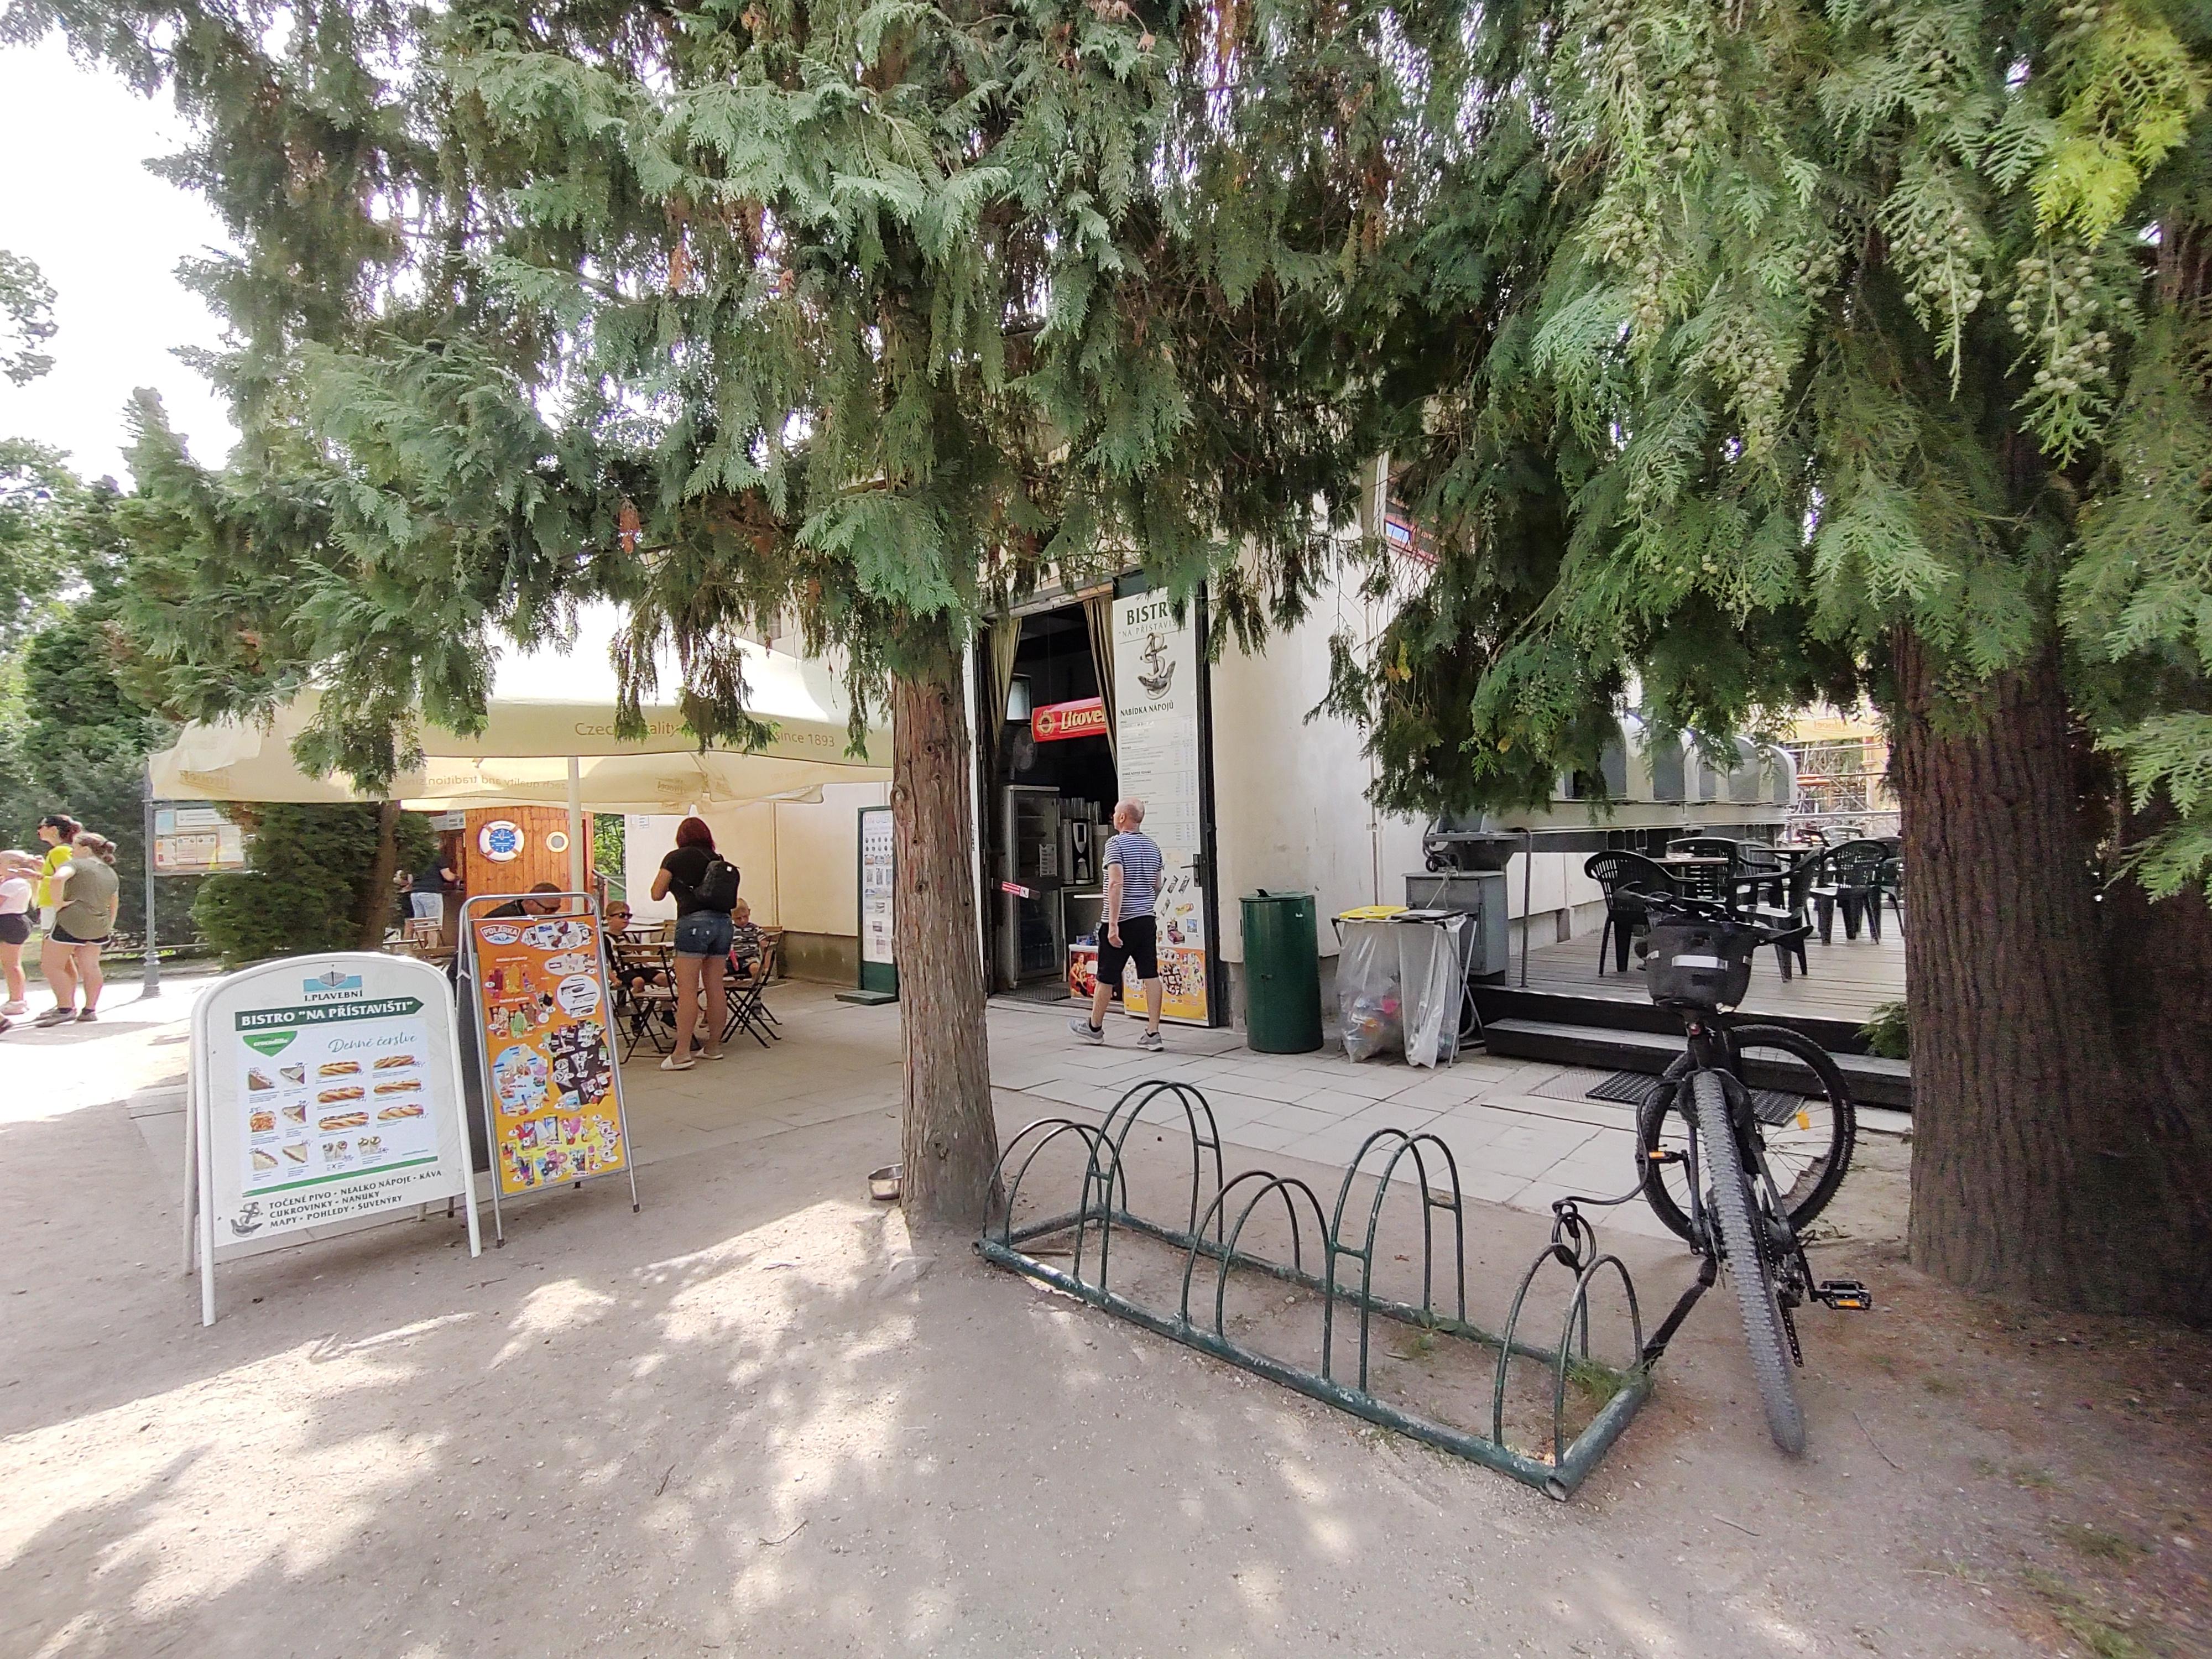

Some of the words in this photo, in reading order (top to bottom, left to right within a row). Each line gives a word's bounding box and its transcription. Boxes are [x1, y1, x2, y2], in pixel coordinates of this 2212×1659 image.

[1127, 602, 1168, 625] BISTR
[1120, 706, 1147, 717] NABÍDKA
[1149, 700, 1173, 712] NÁPOJŮ
[575, 722, 614, 735] Czec
[650, 721, 677, 737] ality
[775, 731, 805, 744] since
[808, 733, 835, 747] 1893
[241, 1012, 295, 1026] BISTRO
[328, 1038, 374, 1052] Denně
[270, 1194, 306, 1209] TOČENÉ
[309, 1192, 331, 1202] PIVO
[341, 1183, 376, 1196] NEALKO
[378, 1176, 411, 1188] NÁPOJE
[420, 1170, 442, 1180] KÁVA
[270, 1201, 332, 1218] CUKROVINKY
[342, 1191, 380, 1204] NANUKY
[270, 1216, 297, 1228] MAPY
[307, 1206, 349, 1220] POHLEDY
[358, 1194, 402, 1210] SUVENÝRY
